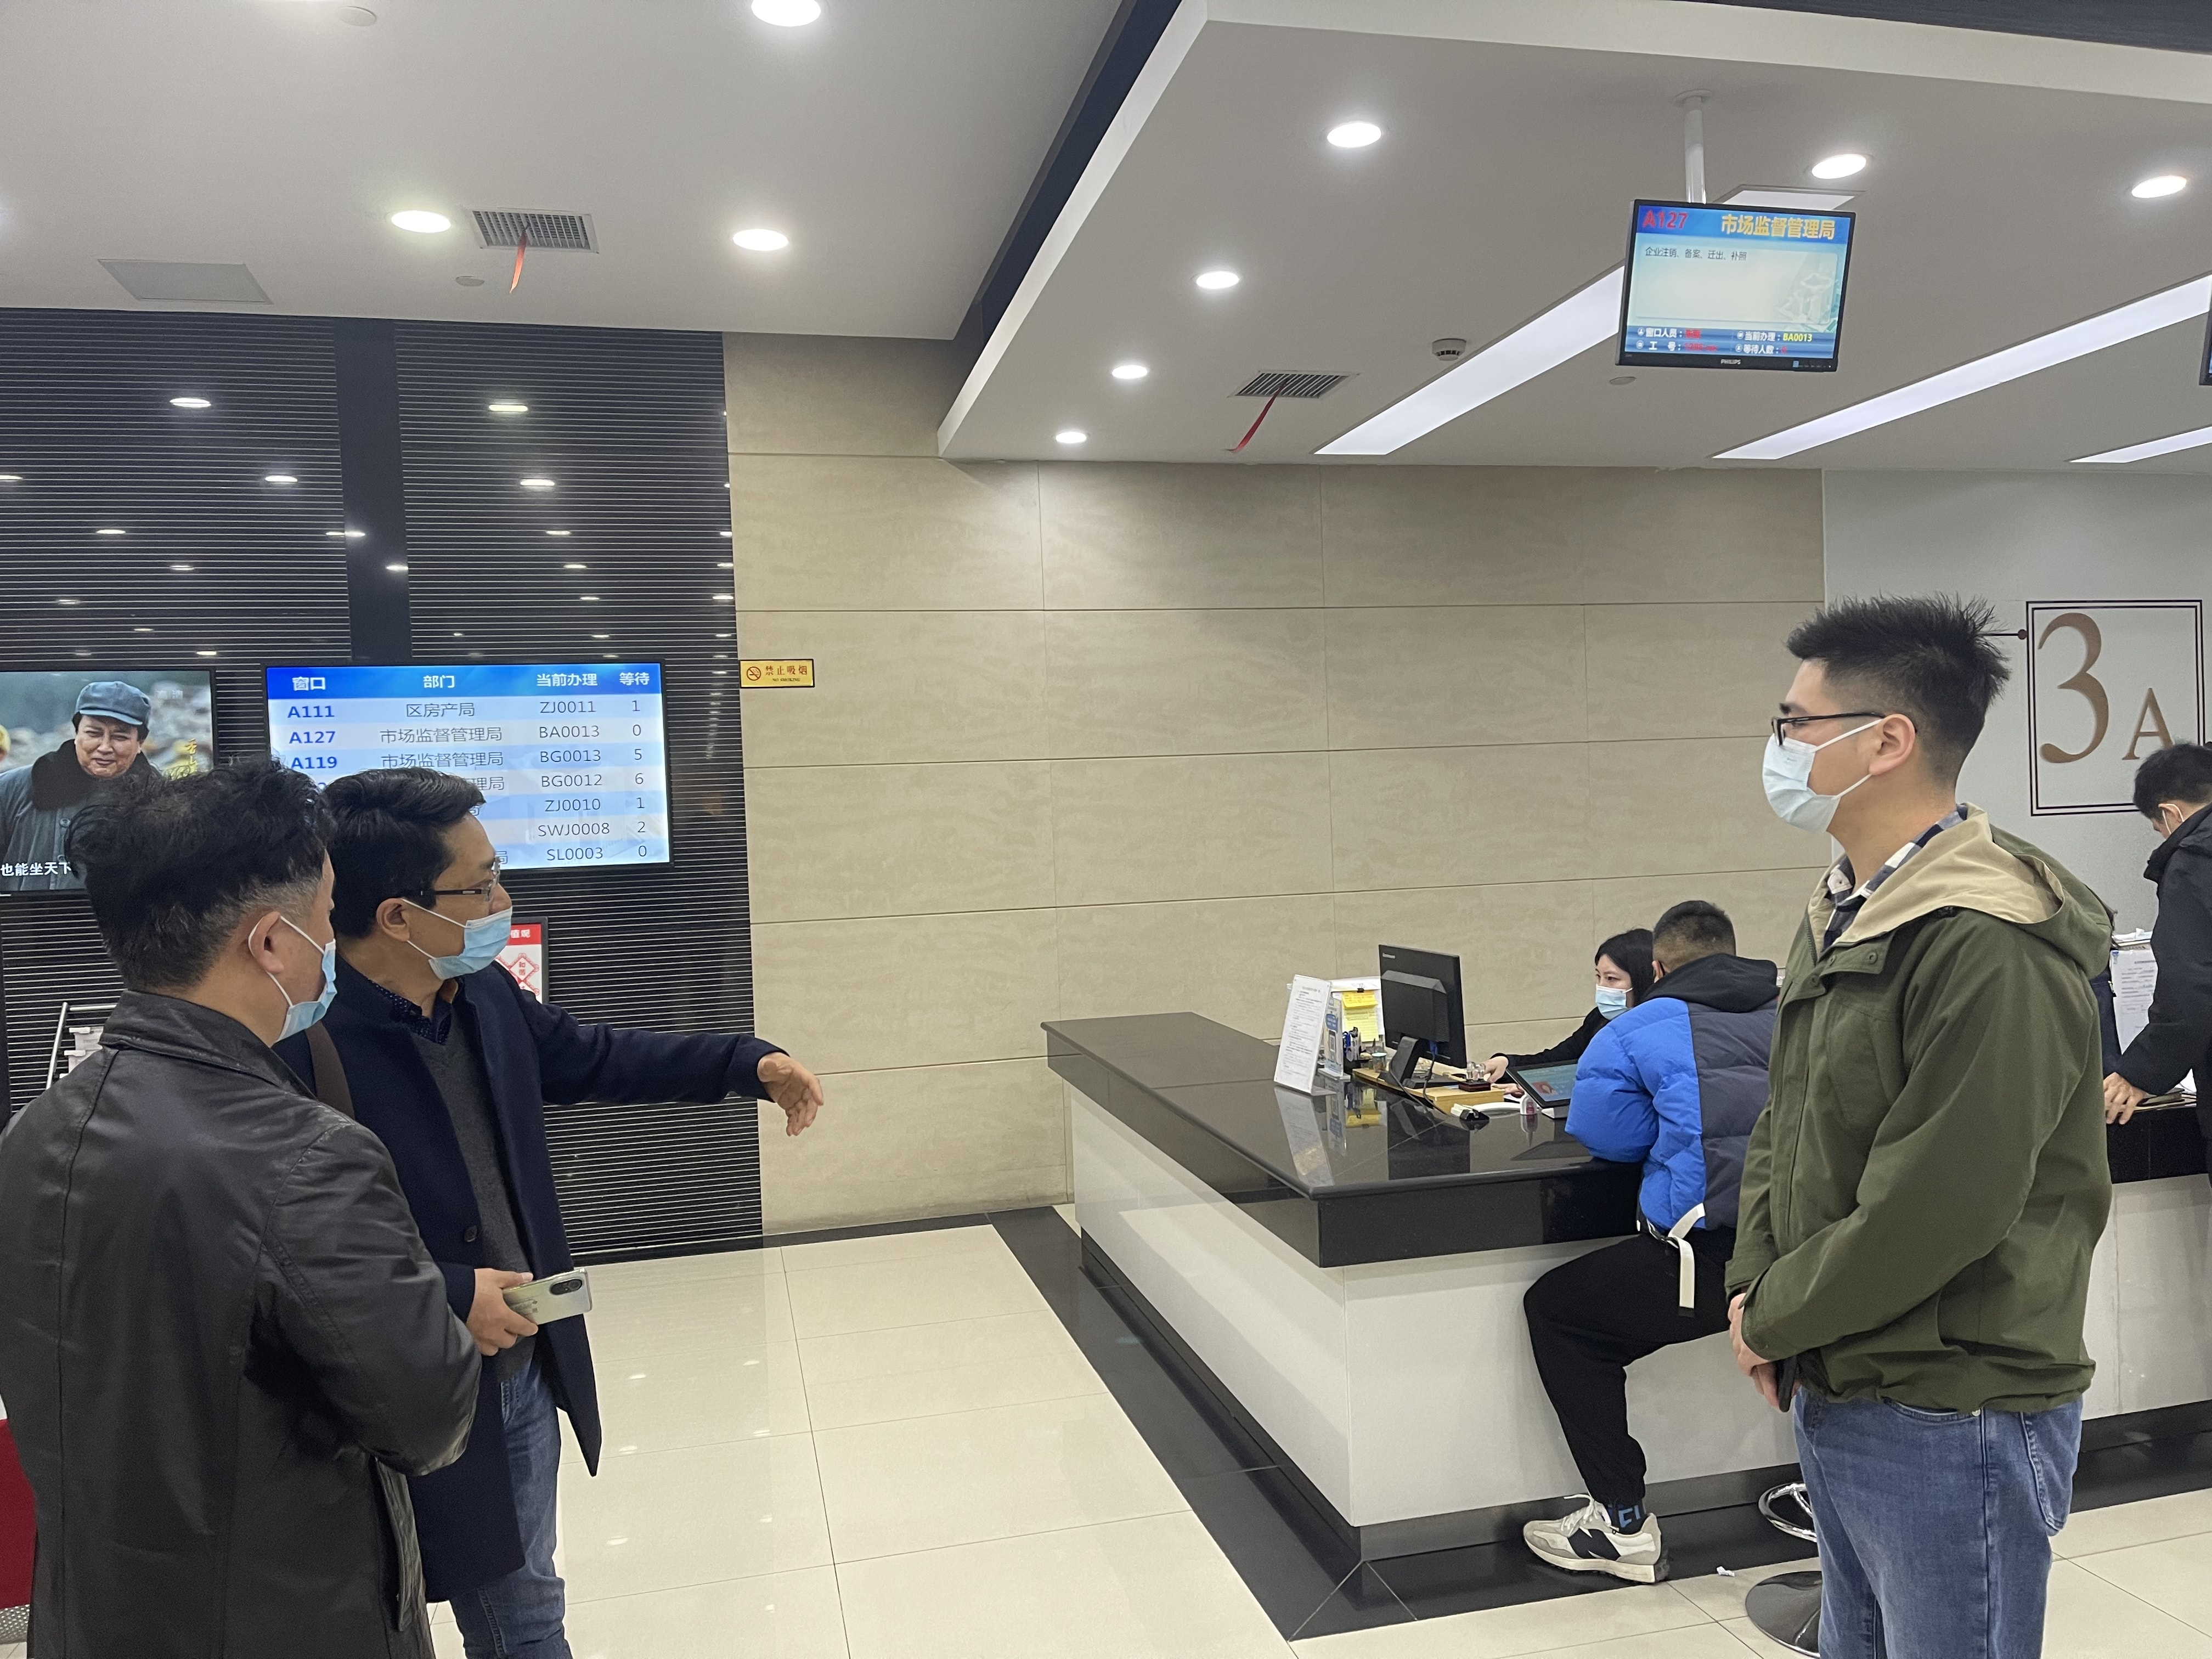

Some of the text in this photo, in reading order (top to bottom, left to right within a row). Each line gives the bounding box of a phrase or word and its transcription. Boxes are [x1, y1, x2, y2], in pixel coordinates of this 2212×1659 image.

[1642, 210, 1688, 229] A127
[1721, 213, 1836, 240] 市场监督管理局
[1782, 332, 1813, 342] BA0013
[765, 665, 808, 676] 禁止吸烟
[292, 672, 650, 691] 窗口 部门 当前办理 等待
[287, 700, 641, 718] A111 区房产局 ZJ0011 1
[289, 724, 642, 744] A127 市场监督管理局 BA0013 0
[291, 748, 642, 769] A119 市场监督管理局 BG0013 5
[541, 774, 603, 787] BG0012
[635, 772, 644, 785] 6
[545, 797, 645, 812] ZJ0010 1
[538, 821, 646, 837] SWJ0008 2
[546, 847, 603, 861] SL0003
[638, 845, 647, 857] 0
[0, 862, 72, 877] 也能坐天下
